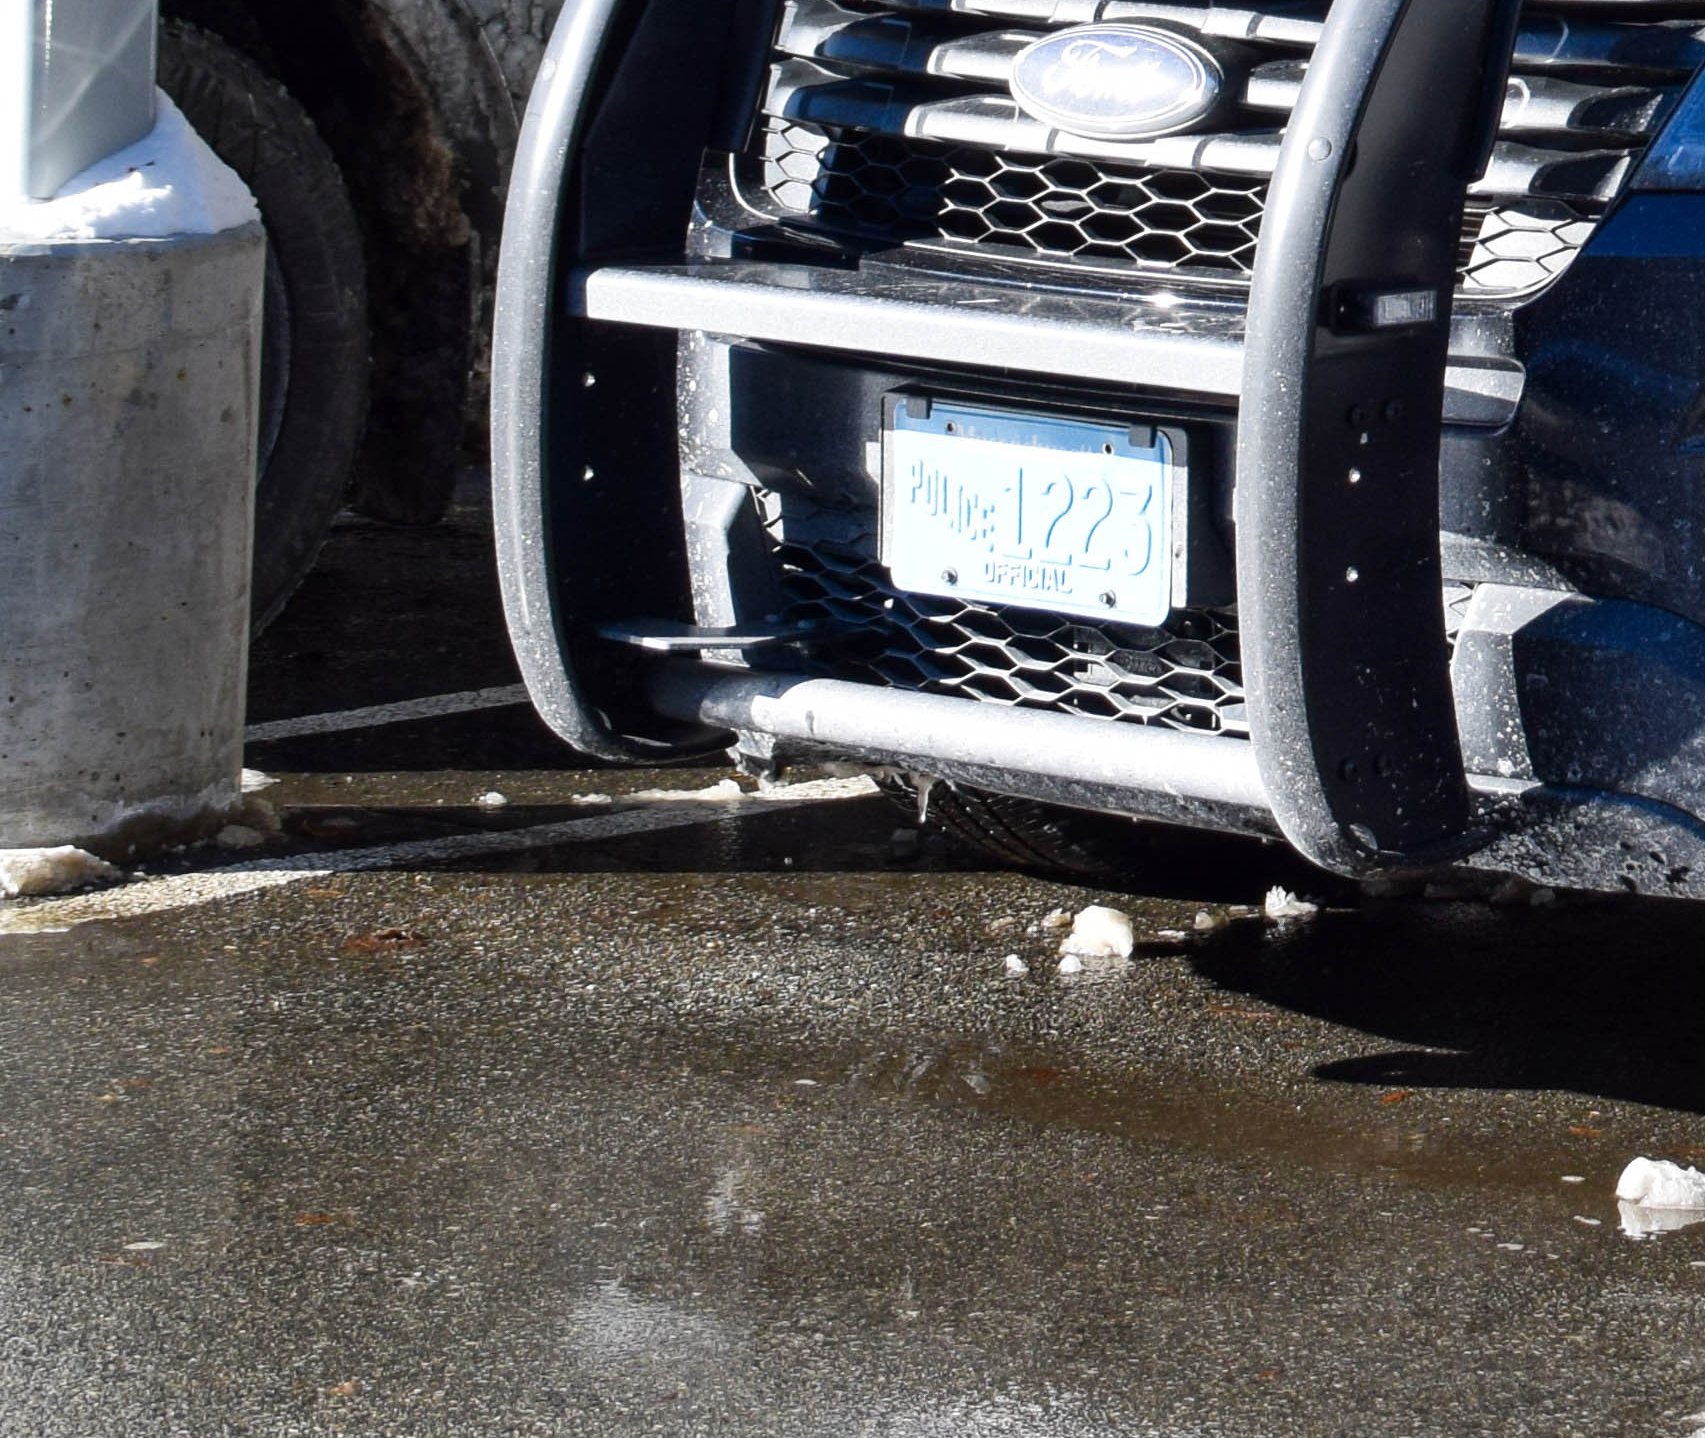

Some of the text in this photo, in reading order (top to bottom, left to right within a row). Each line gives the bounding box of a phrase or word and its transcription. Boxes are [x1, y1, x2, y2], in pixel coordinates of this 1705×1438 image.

[909, 460, 1153, 578] POLICE 1223
[984, 562, 1073, 594] OFFICIAL
